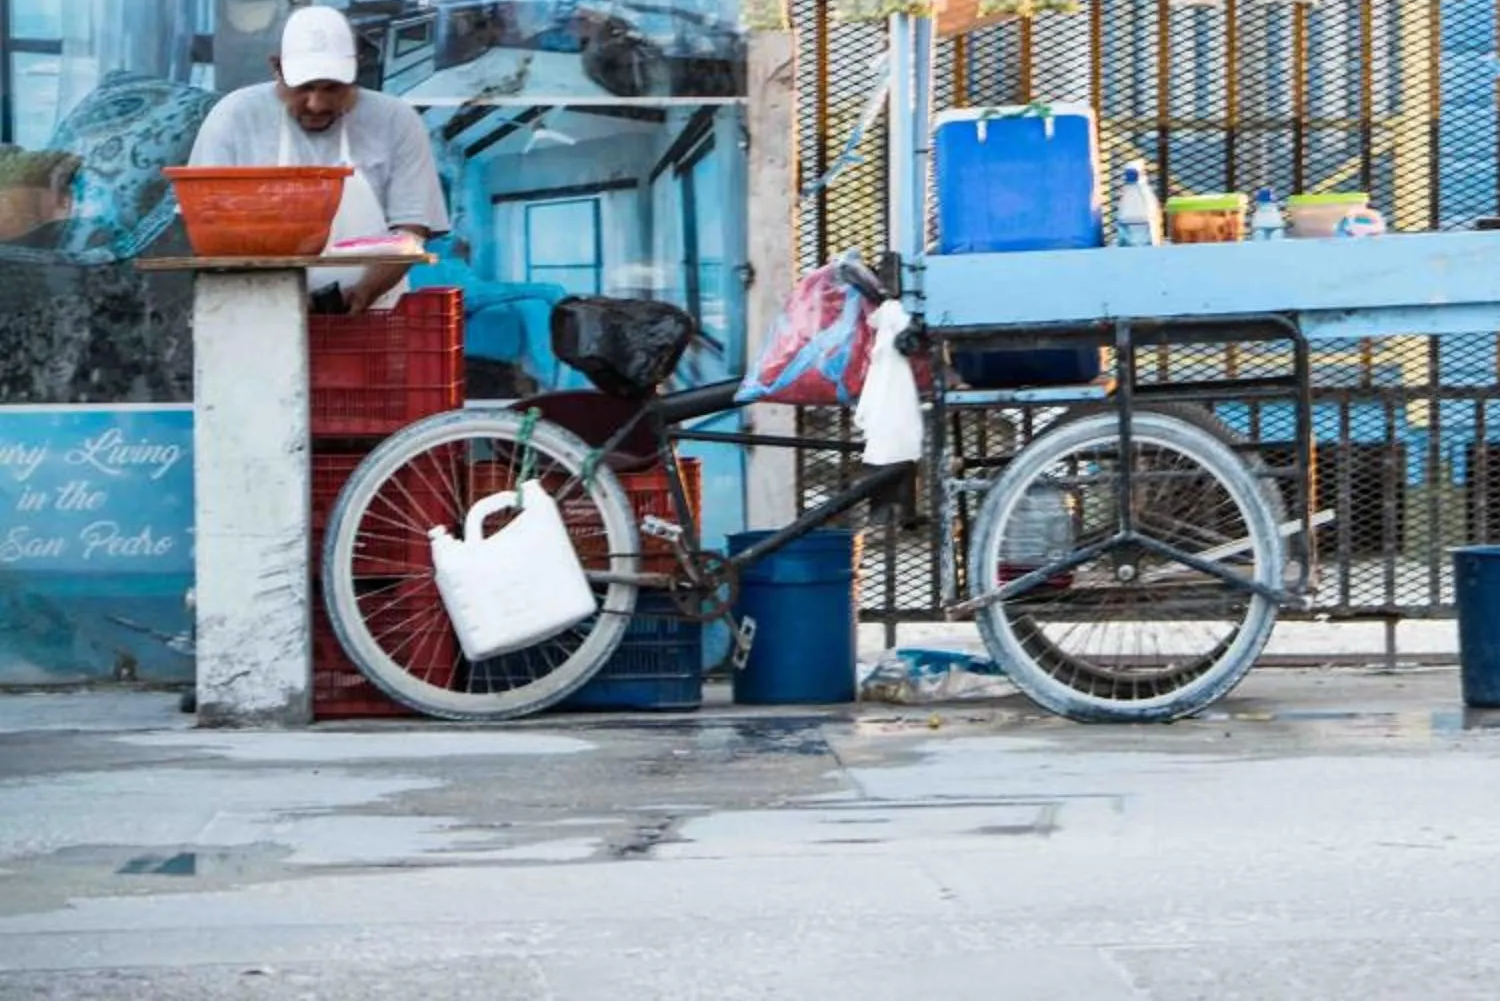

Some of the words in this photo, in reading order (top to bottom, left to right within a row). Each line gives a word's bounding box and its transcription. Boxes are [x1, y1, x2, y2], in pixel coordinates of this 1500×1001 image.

[64, 427, 181, 480] Living
[16, 485, 47, 511] in
[54, 480, 107, 511] the
[0, 525, 66, 562] San
[79, 520, 174, 561] Pedro
